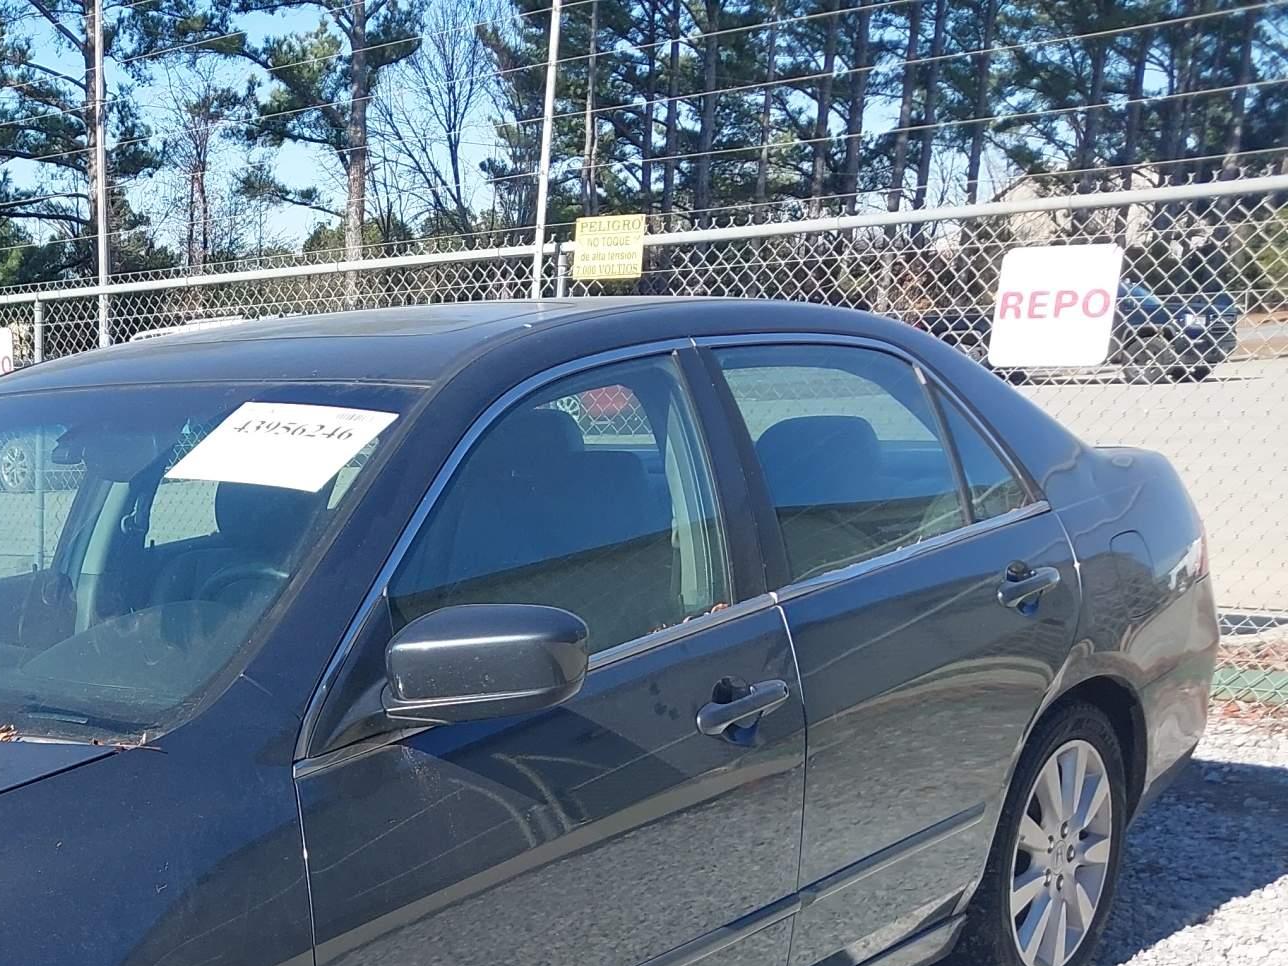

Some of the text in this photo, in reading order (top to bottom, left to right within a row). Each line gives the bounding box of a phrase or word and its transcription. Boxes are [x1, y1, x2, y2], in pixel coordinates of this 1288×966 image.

[580, 219, 641, 233] PELIGRO
[587, 236, 631, 248] NO TOQUE
[599, 263, 638, 275] VOLTIOS
[999, 288, 1111, 320] REPO
[232, 419, 354, 441] 43956246
